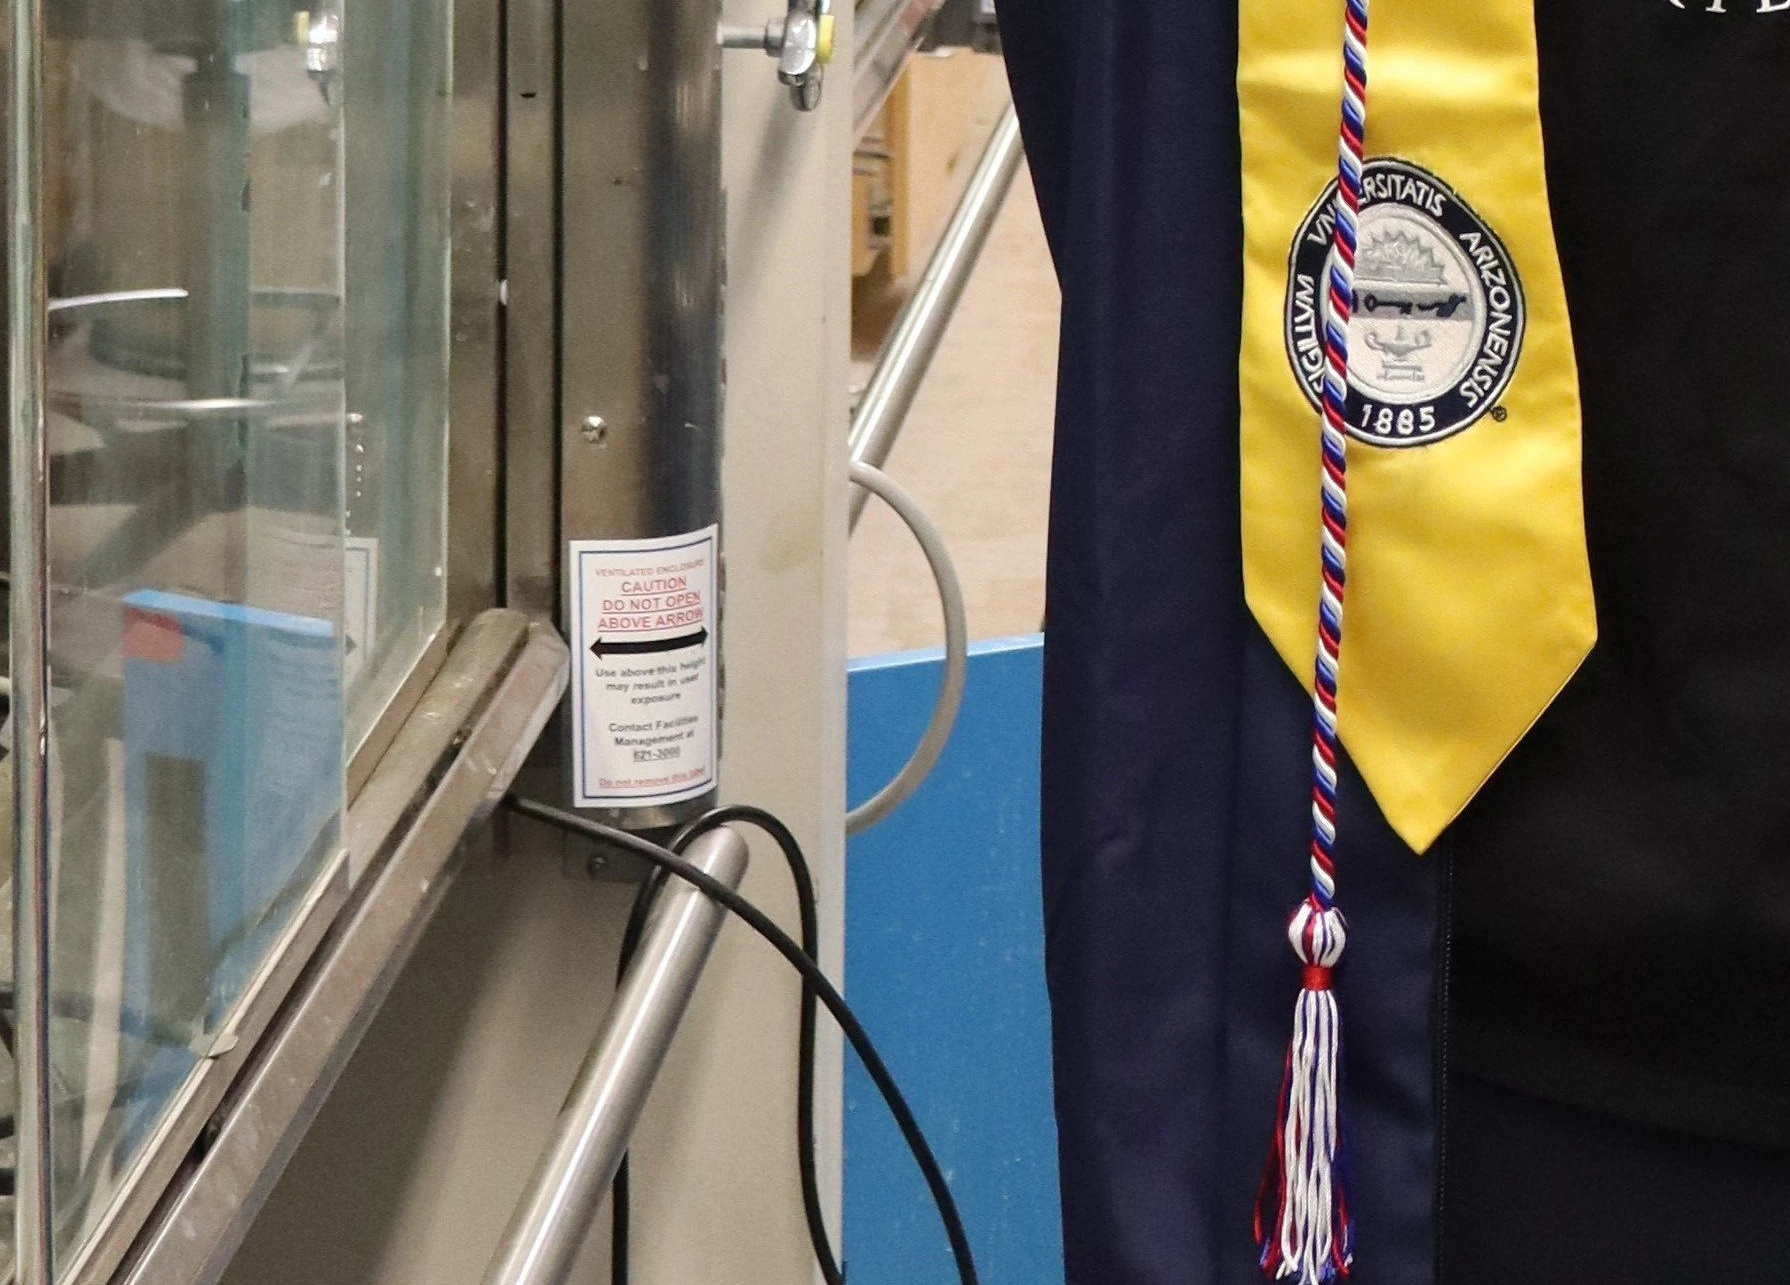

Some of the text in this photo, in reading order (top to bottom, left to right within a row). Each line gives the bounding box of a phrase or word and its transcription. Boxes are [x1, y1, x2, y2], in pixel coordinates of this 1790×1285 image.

[1307, 173, 1447, 246] VNRSITATIS
[1459, 231, 1513, 409] ARIZONENSIS
[1361, 403, 1436, 435] 1885
[595, 567, 653, 577] VENTILATED
[621, 576, 687, 593] CAUTION
[602, 591, 701, 611] DO NOT OPEN
[599, 607, 704, 629] ABOVE ARROW
[595, 656, 706, 678] Use above this height
[606, 673, 699, 693] may result in user
[631, 693, 681, 705] exposure
[609, 715, 699, 733] Contact Facilities
[614, 730, 695, 747] Management at
